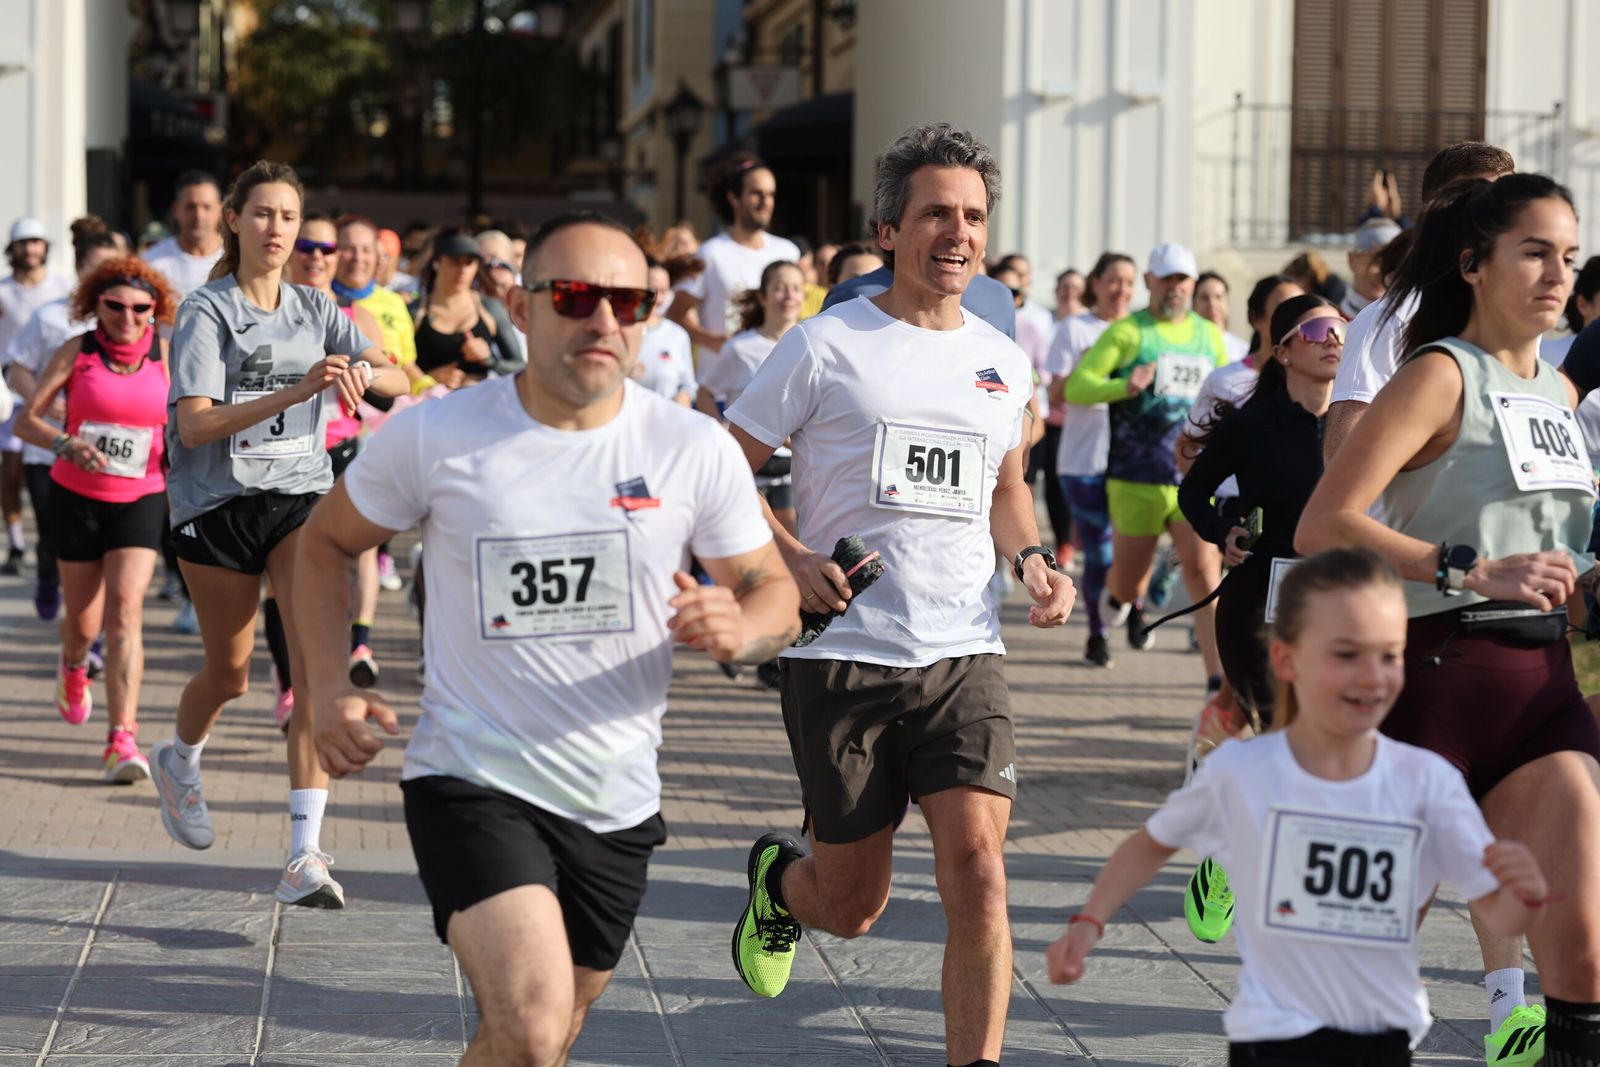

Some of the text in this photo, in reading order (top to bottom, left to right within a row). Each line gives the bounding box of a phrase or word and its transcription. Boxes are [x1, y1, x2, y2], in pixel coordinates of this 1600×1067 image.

[240, 344, 273, 375] 4
[270, 411, 285, 436] 3
[1528, 417, 1579, 460] 408
[96, 436, 134, 458] 456
[905, 444, 961, 487] 501
[510, 556, 595, 607] 357
[1304, 841, 1395, 903] 503
